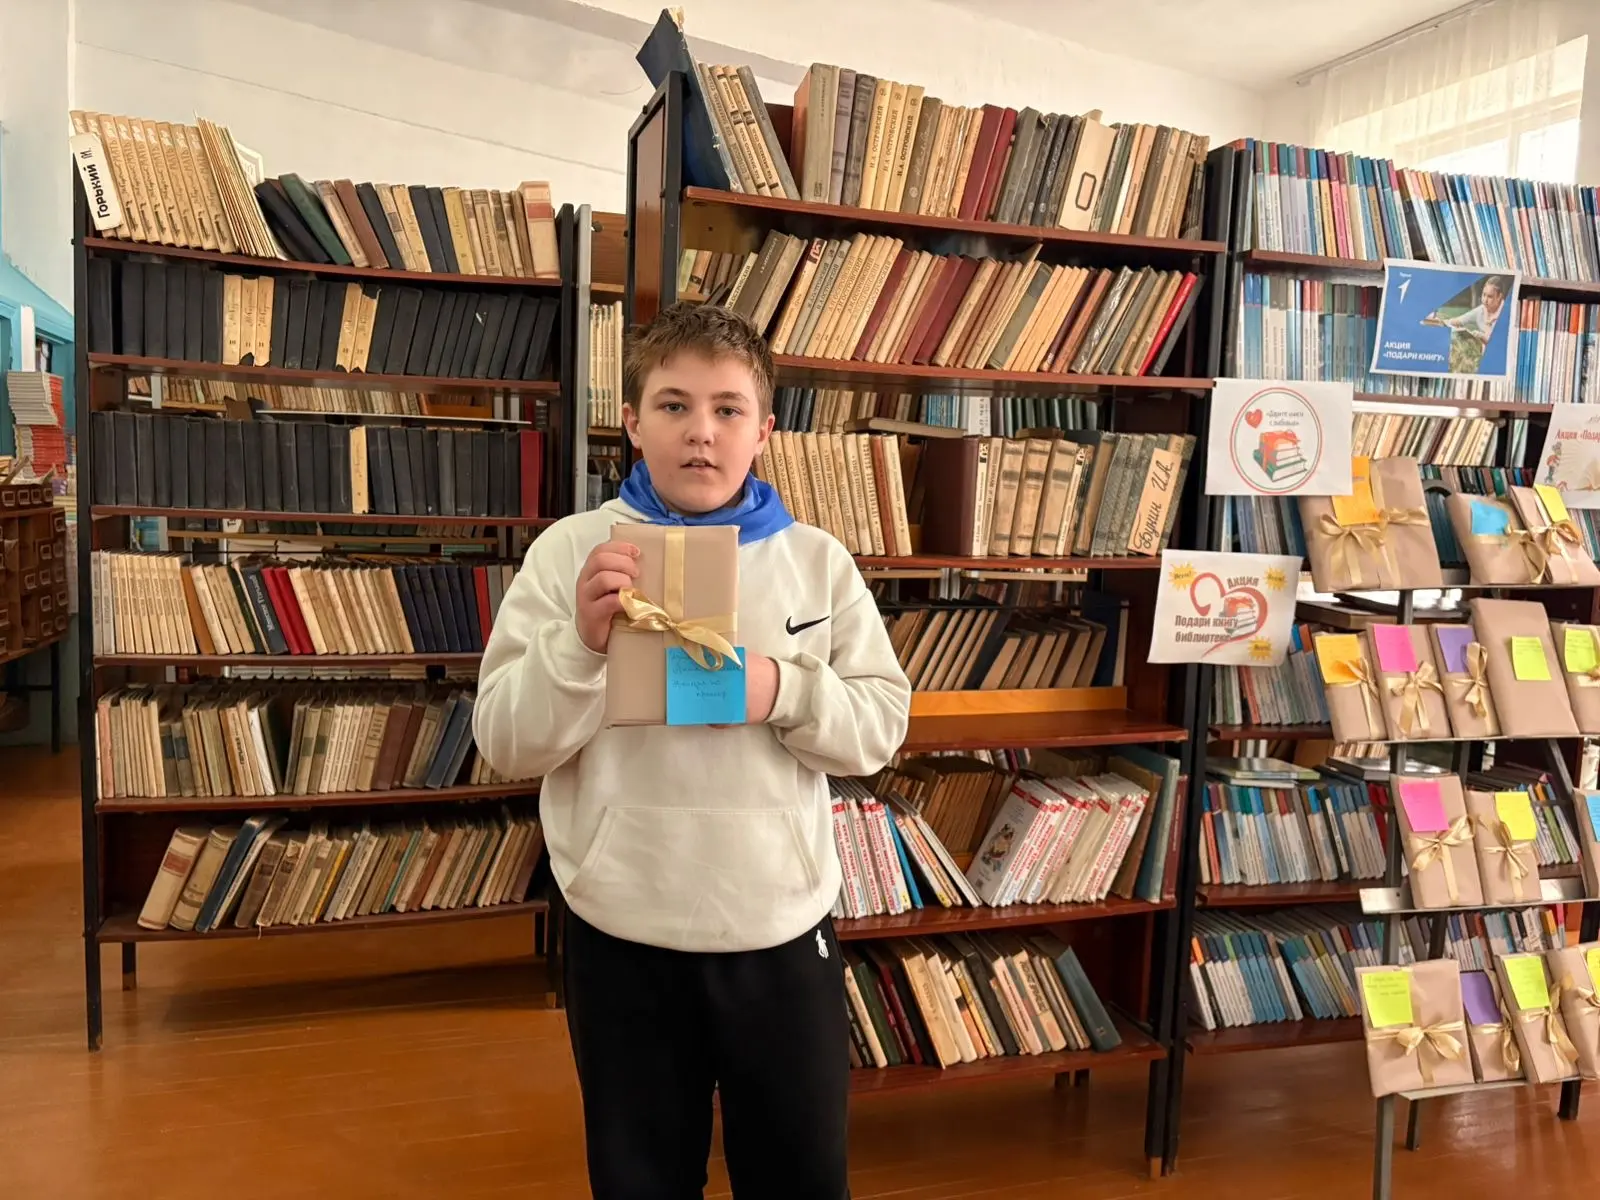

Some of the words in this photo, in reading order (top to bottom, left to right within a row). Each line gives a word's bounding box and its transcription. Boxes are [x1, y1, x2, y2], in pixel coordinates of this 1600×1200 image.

[83, 163, 110, 220] Горький
[1384, 341, 1411, 350] АКЦИЯ
[1131, 498, 1167, 553] Бунин
[1174, 615, 1211, 628] Подари
[1212, 617, 1239, 628] книгу
